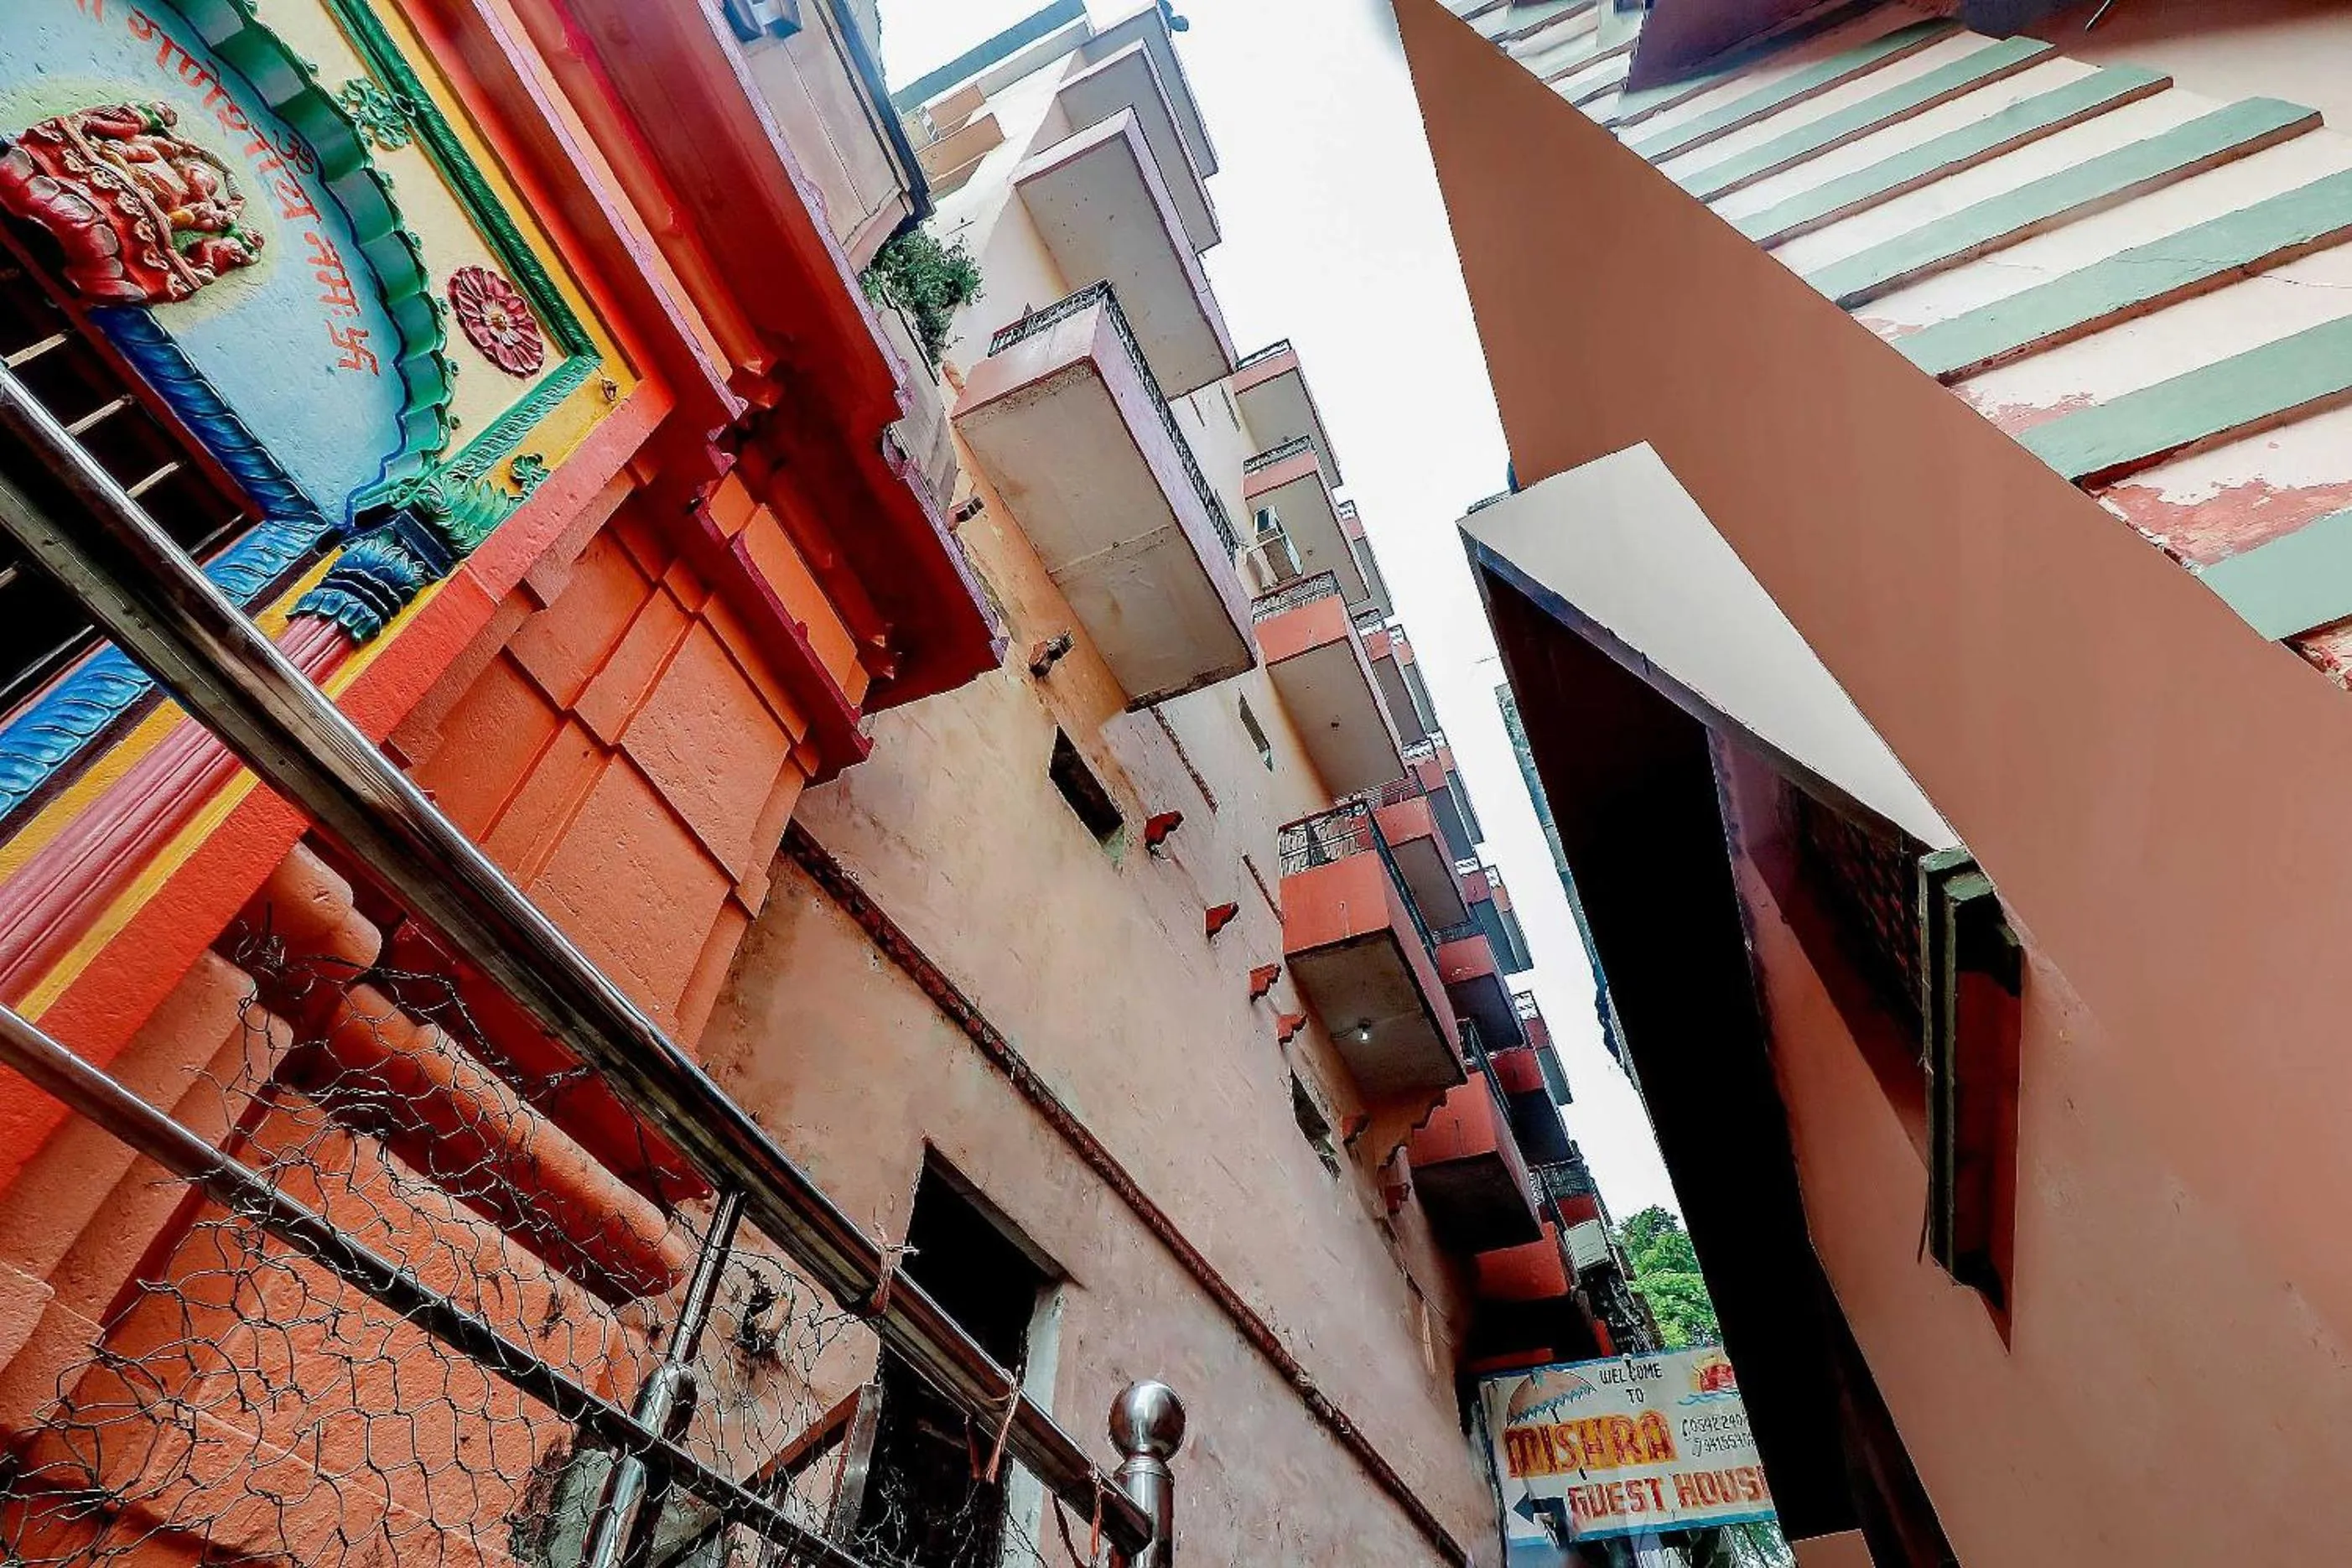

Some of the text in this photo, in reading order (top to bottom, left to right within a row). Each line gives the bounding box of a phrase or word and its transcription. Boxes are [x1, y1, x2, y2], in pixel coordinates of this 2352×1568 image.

[1599, 1362, 1663, 1385] WELCOME
[1625, 1387, 1644, 1404] TO
[1504, 1410, 1676, 1477] MISHRA
[1567, 1477, 1666, 1523] GUEST
